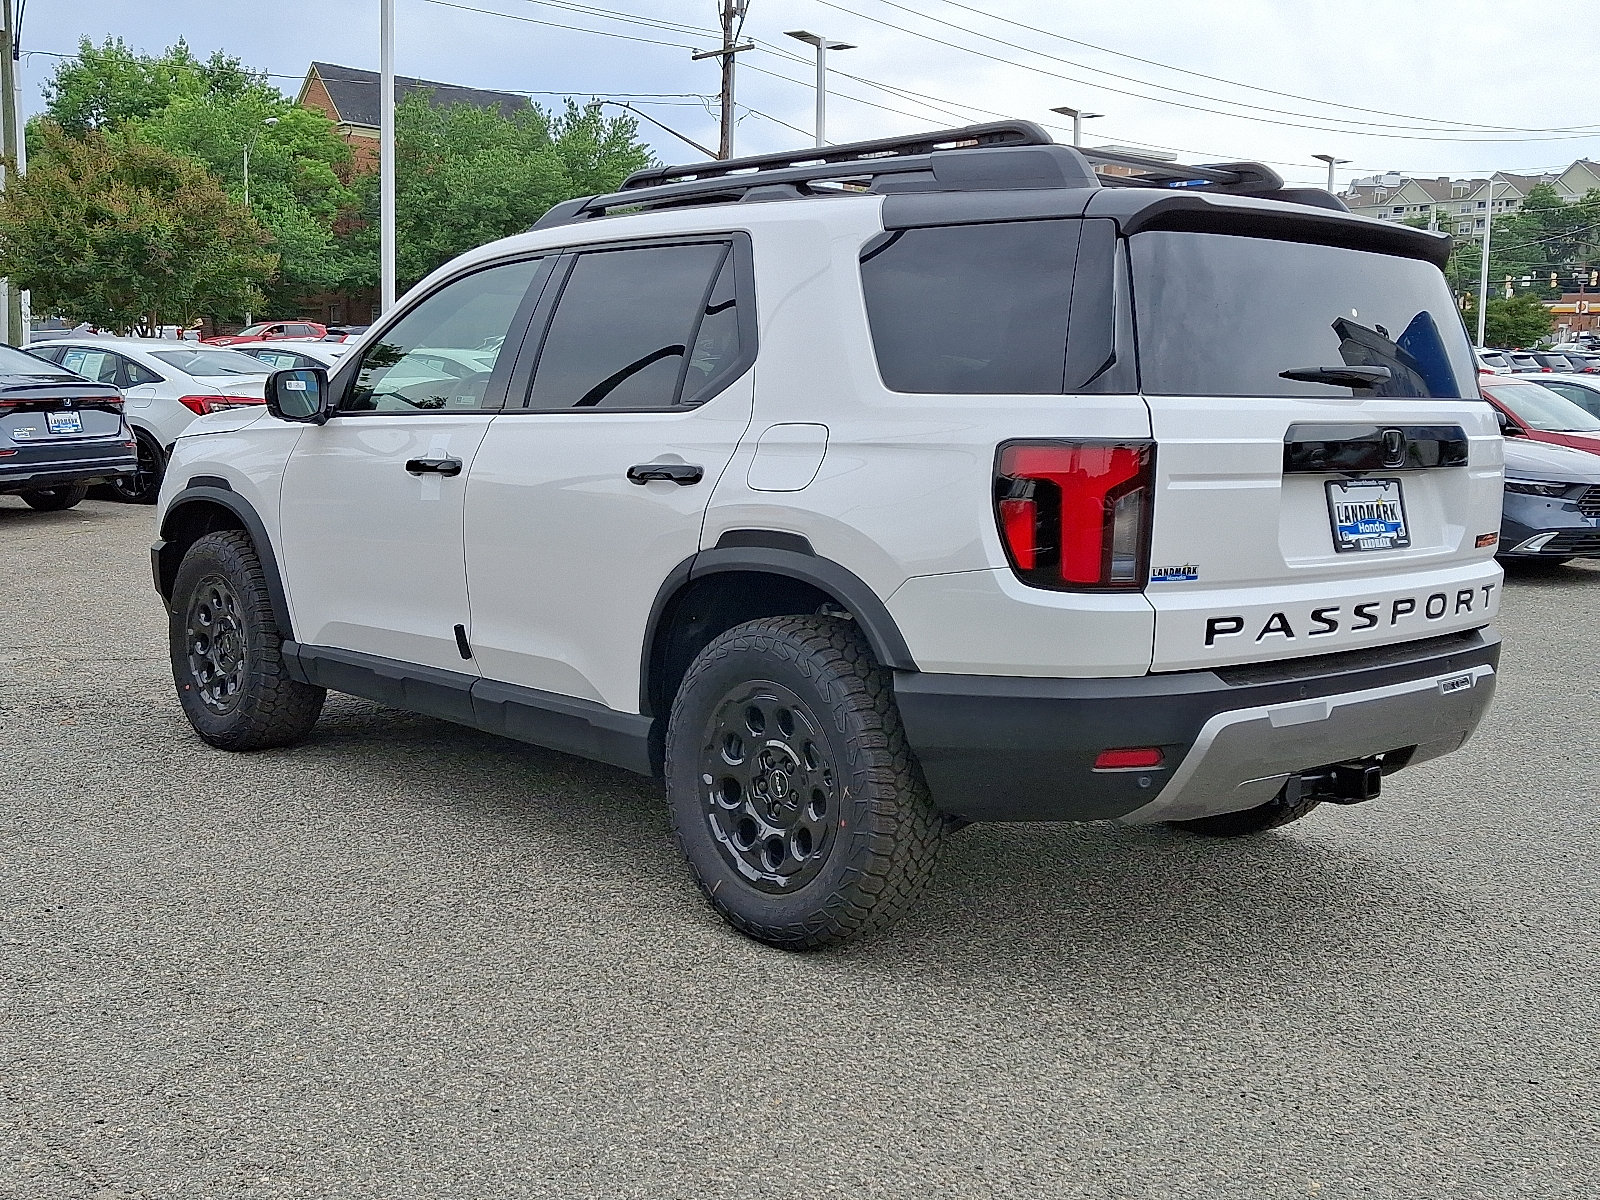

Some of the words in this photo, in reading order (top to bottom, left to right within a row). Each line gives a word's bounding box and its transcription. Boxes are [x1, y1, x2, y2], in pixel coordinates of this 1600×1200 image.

[1336, 503, 1399, 524] LANDMARK
[1358, 521, 1386, 533] Honda
[1152, 566, 1198, 577] LANDMARK
[1204, 584, 1496, 647] PASSPORT
